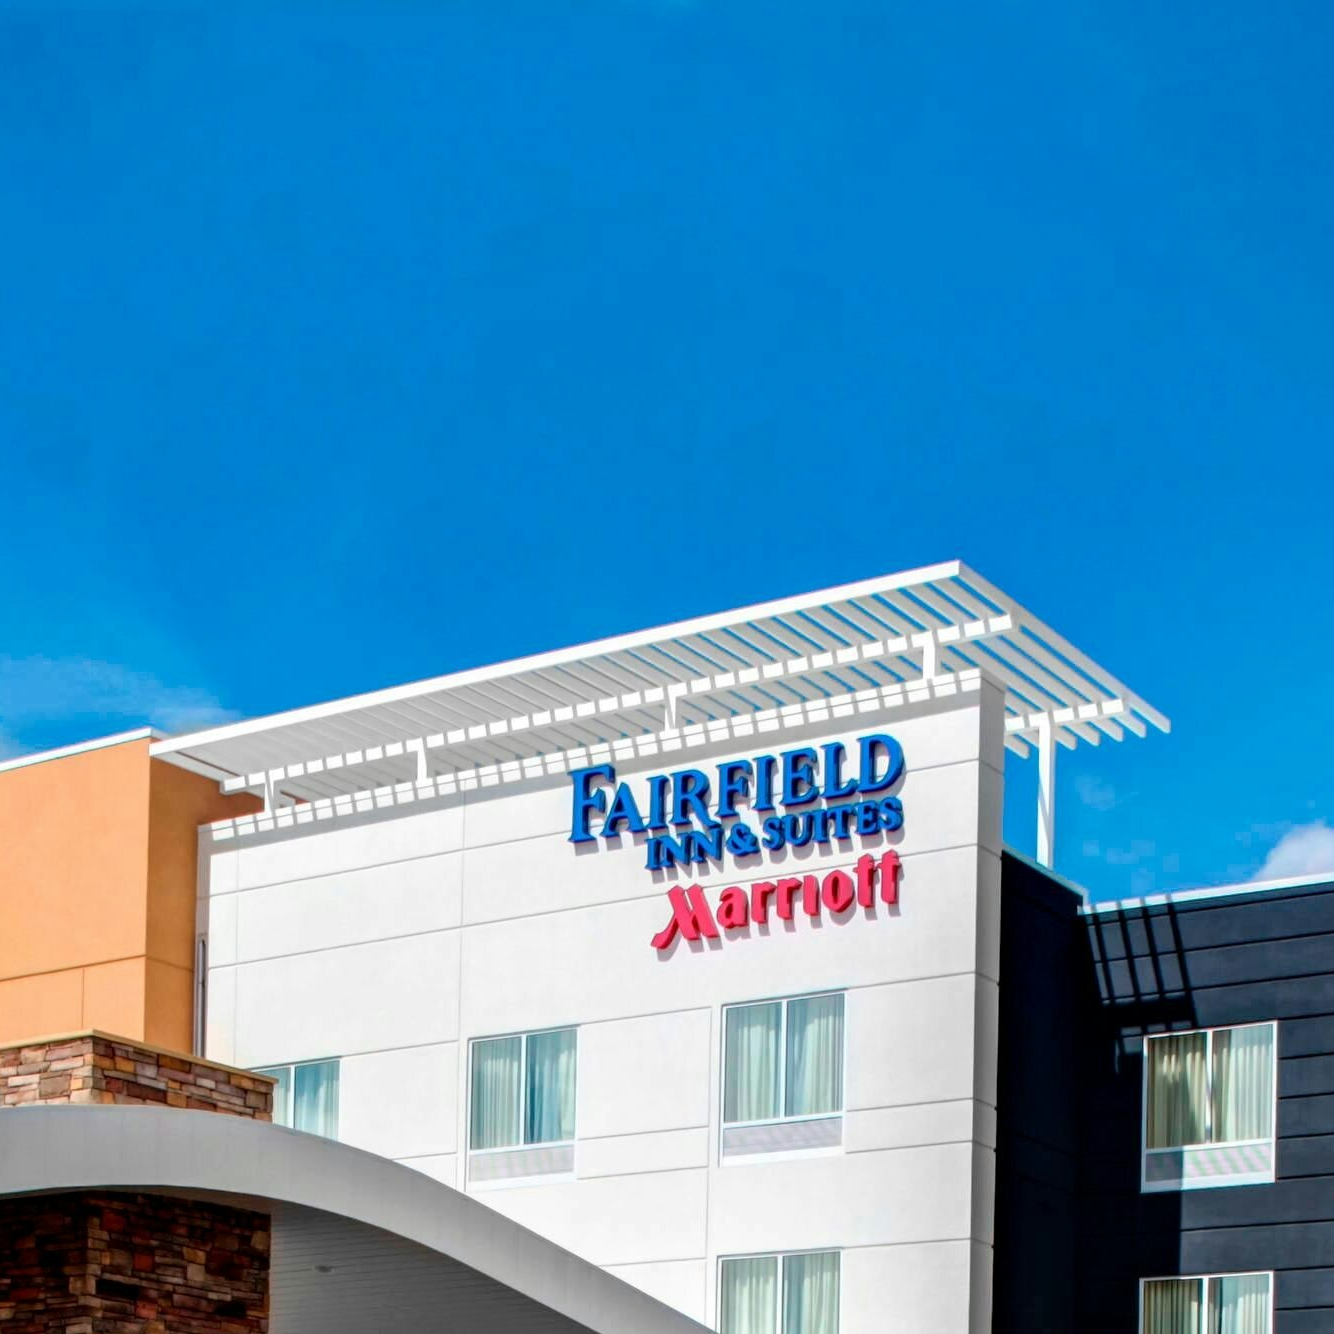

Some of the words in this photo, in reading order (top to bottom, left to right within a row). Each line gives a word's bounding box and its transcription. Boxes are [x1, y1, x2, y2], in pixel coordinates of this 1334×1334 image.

[567, 733, 905, 843] FAIRFIELD
[644, 826, 725, 871] INN
[726, 823, 761, 857] &
[762, 797, 905, 850] SUITES
[651, 849, 901, 949] Marriott
